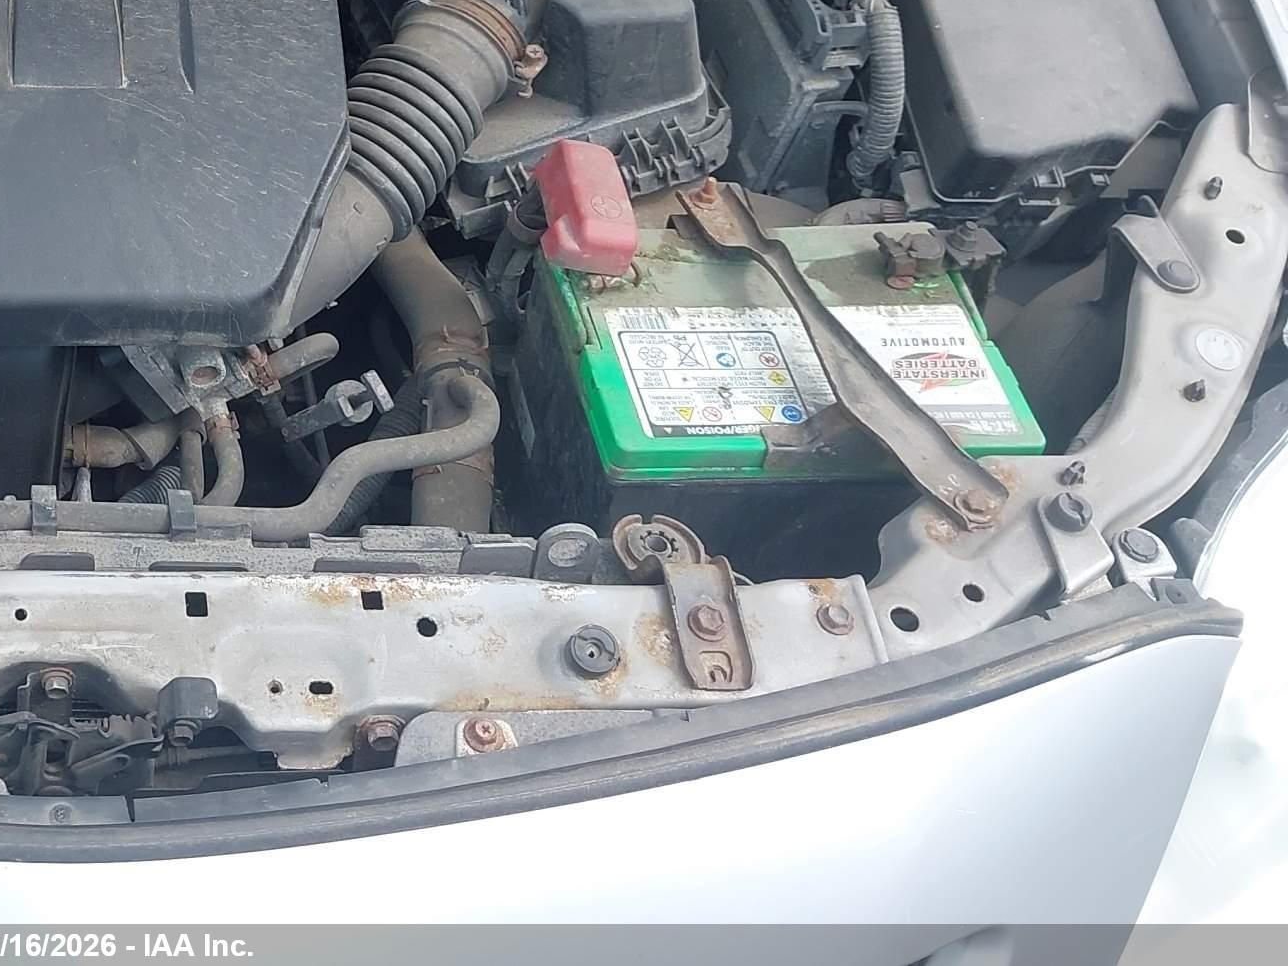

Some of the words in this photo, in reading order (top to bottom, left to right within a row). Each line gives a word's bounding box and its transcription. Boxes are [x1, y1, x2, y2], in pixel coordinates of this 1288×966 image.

[880, 337, 965, 347] AUTOMOTIVE
[893, 359, 978, 369] BATTERIES
[892, 369, 986, 379] INTERSTATE
